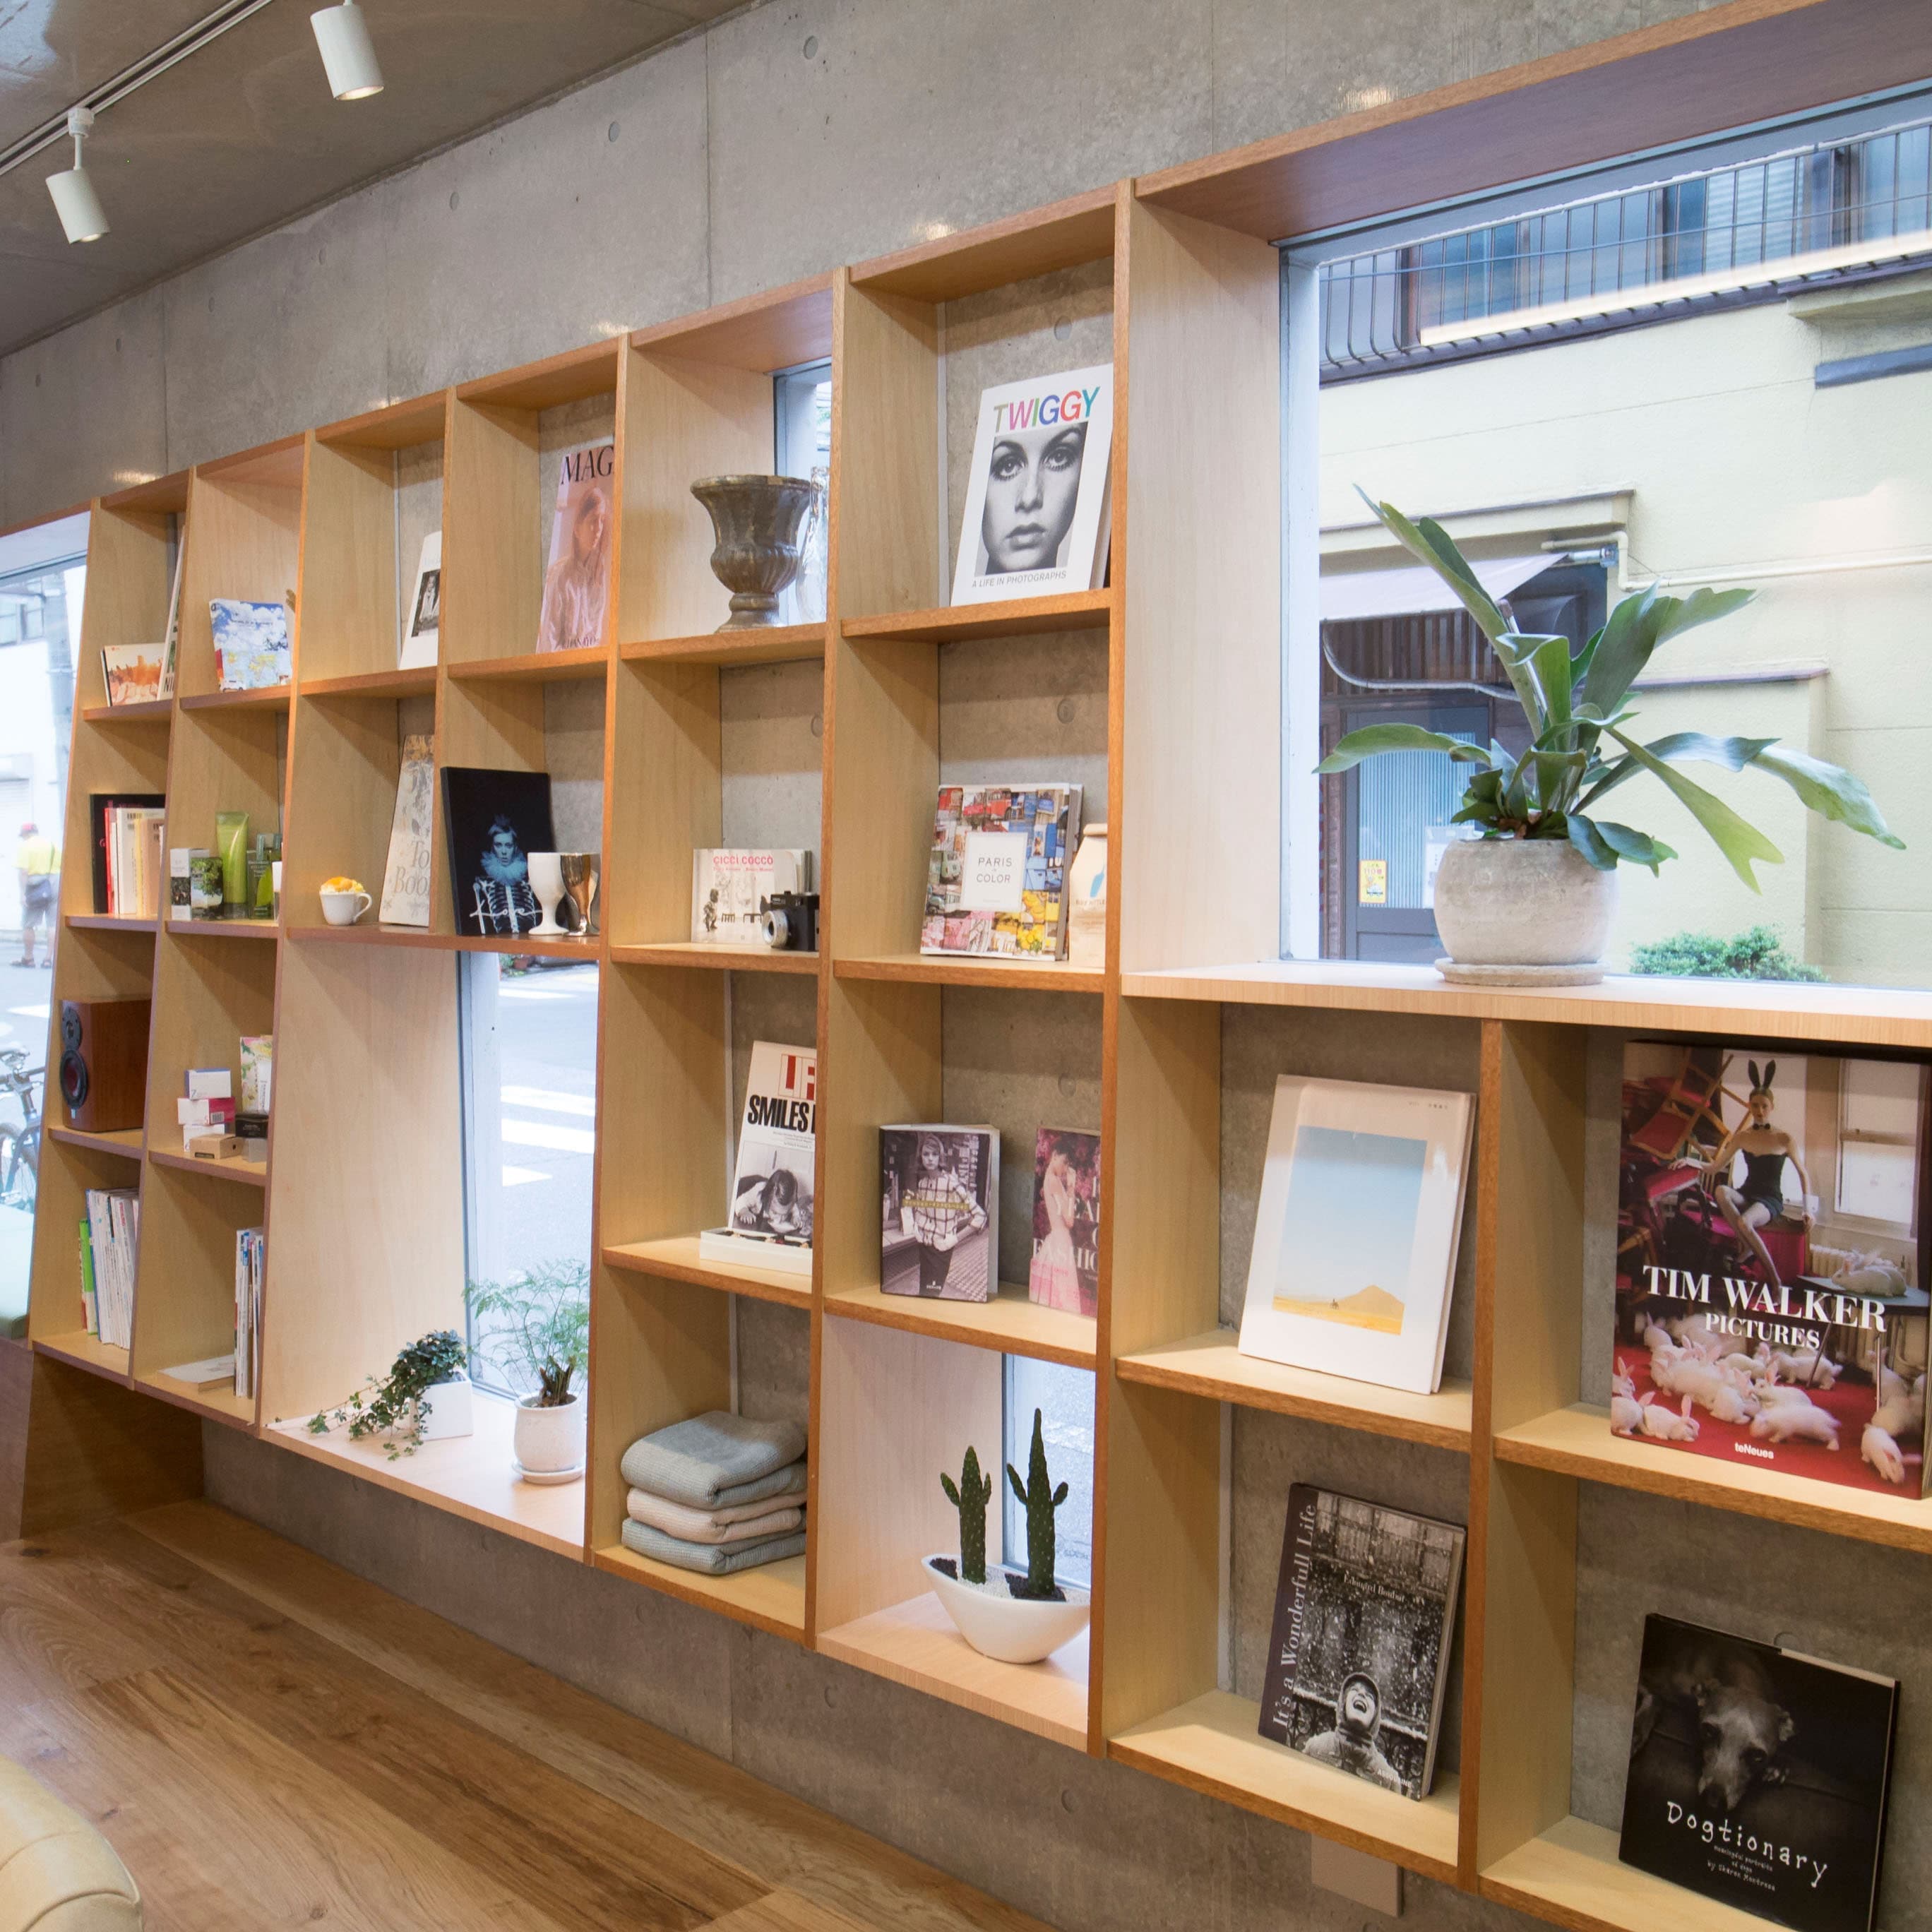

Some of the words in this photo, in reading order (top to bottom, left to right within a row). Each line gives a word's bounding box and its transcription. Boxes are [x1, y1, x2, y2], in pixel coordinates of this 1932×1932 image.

[994, 386, 1100, 433] TWIGGY
[561, 446, 614, 485] MAG
[979, 578, 994, 588] LIFE
[996, 577, 1005, 585] IN
[1007, 570, 1066, 584] PHOTOGRAPHS
[976, 873, 1010, 883] COLOR
[978, 857, 1012, 867] PARIS
[747, 1095, 809, 1133] SMILES
[1643, 1265, 1712, 1304] TIM
[1722, 1279, 1888, 1332] WALKER
[1705, 1313, 1821, 1349] PICTURES
[1734, 1442, 1775, 1460] teNeues
[1273, 1695, 1292, 1727] It's
[1283, 1677, 1294, 1690] a
[1296, 1504, 1316, 1546] Life
[1666, 1801, 1827, 1888] Dogtionary
